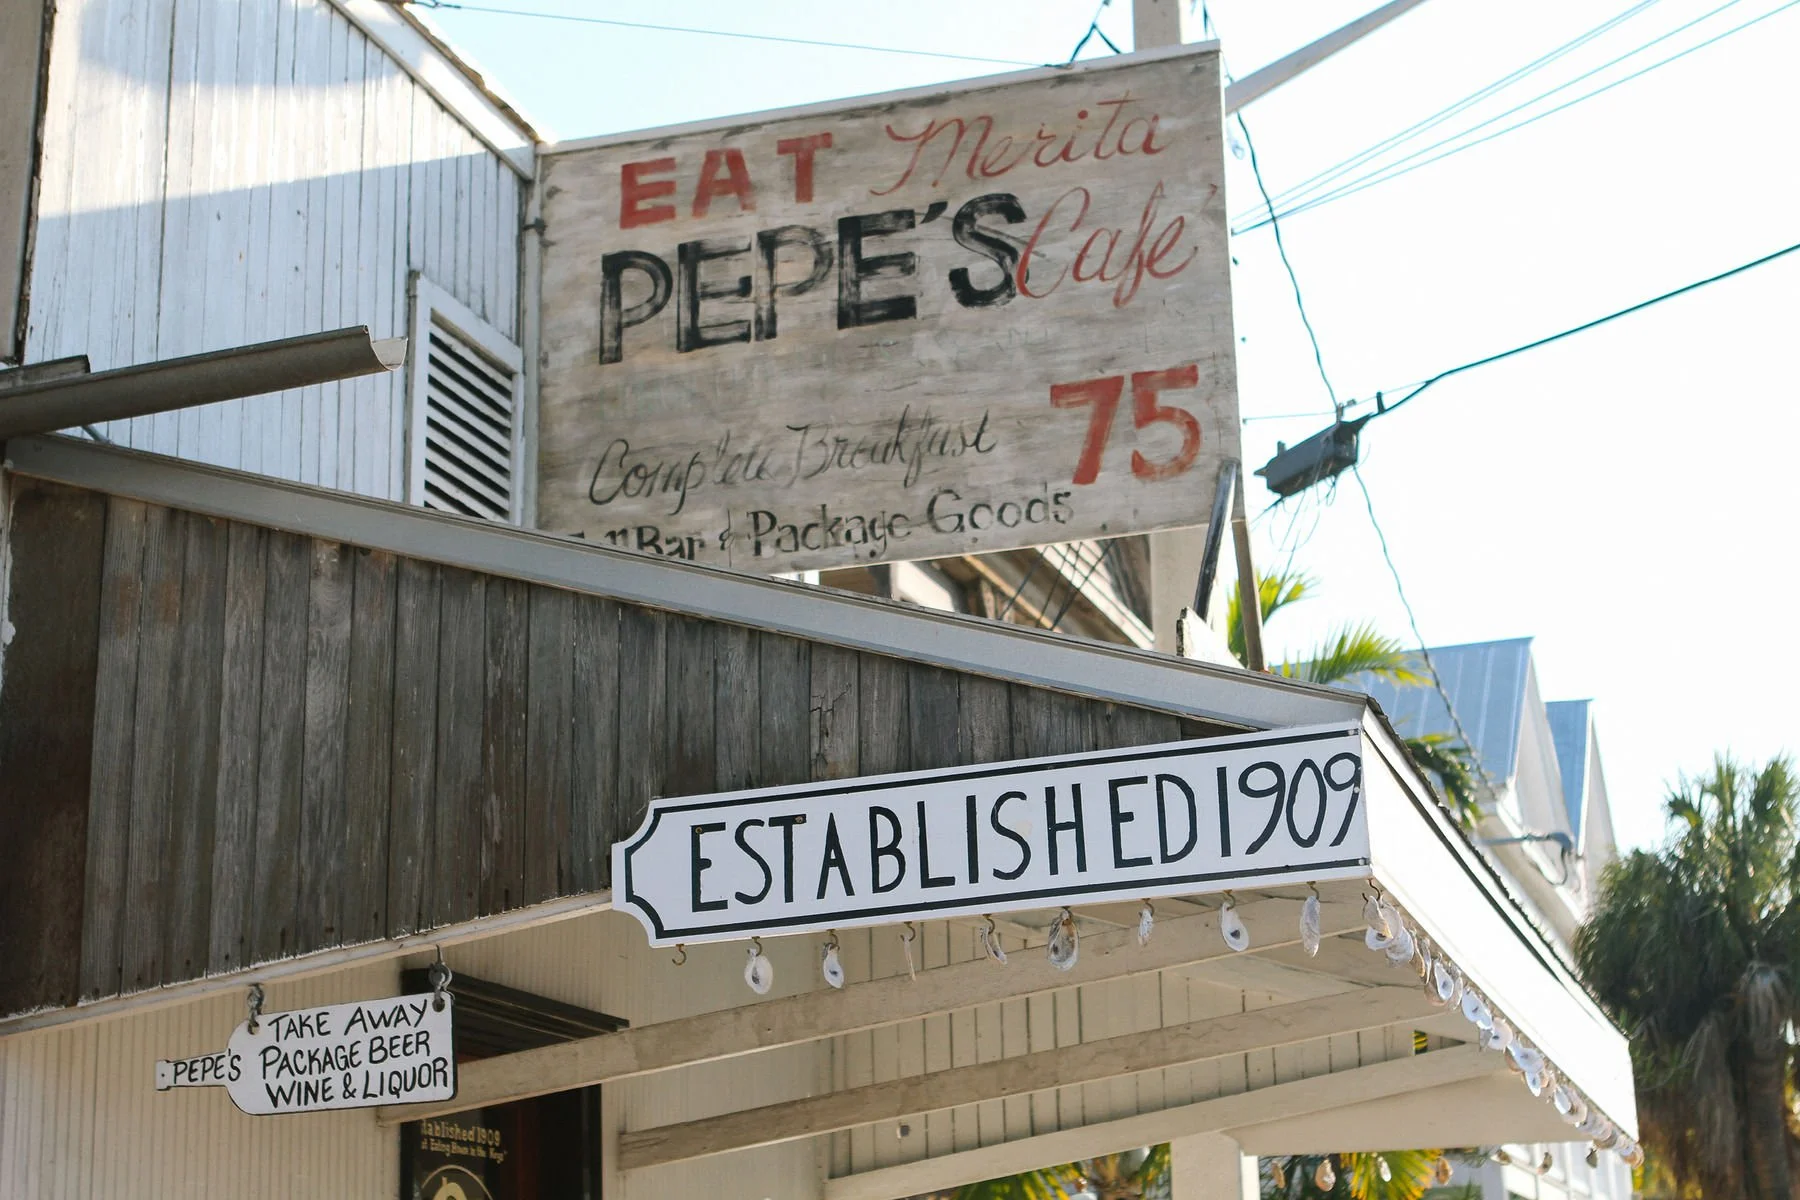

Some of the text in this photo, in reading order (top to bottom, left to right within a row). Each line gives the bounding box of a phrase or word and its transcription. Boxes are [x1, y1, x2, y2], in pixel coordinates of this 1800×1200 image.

[619, 132, 832, 230] EAT
[869, 90, 1170, 195] Merita
[600, 193, 1029, 365] PEPE'S
[781, 404, 999, 488] Breakfast
[1050, 364, 1199, 485] 75
[746, 503, 912, 557] Package
[926, 481, 1074, 535] Goods
[690, 751, 1362, 913] ESTABLISHED 1909
[258, 1030, 431, 1080] PACKAGE BEER
[268, 999, 428, 1043] TAKE AWAY
[172, 1048, 242, 1085] PEPE'S
[265, 1057, 449, 1108] WINE & LIQUOR
[477, 1126, 501, 1147] 1909
